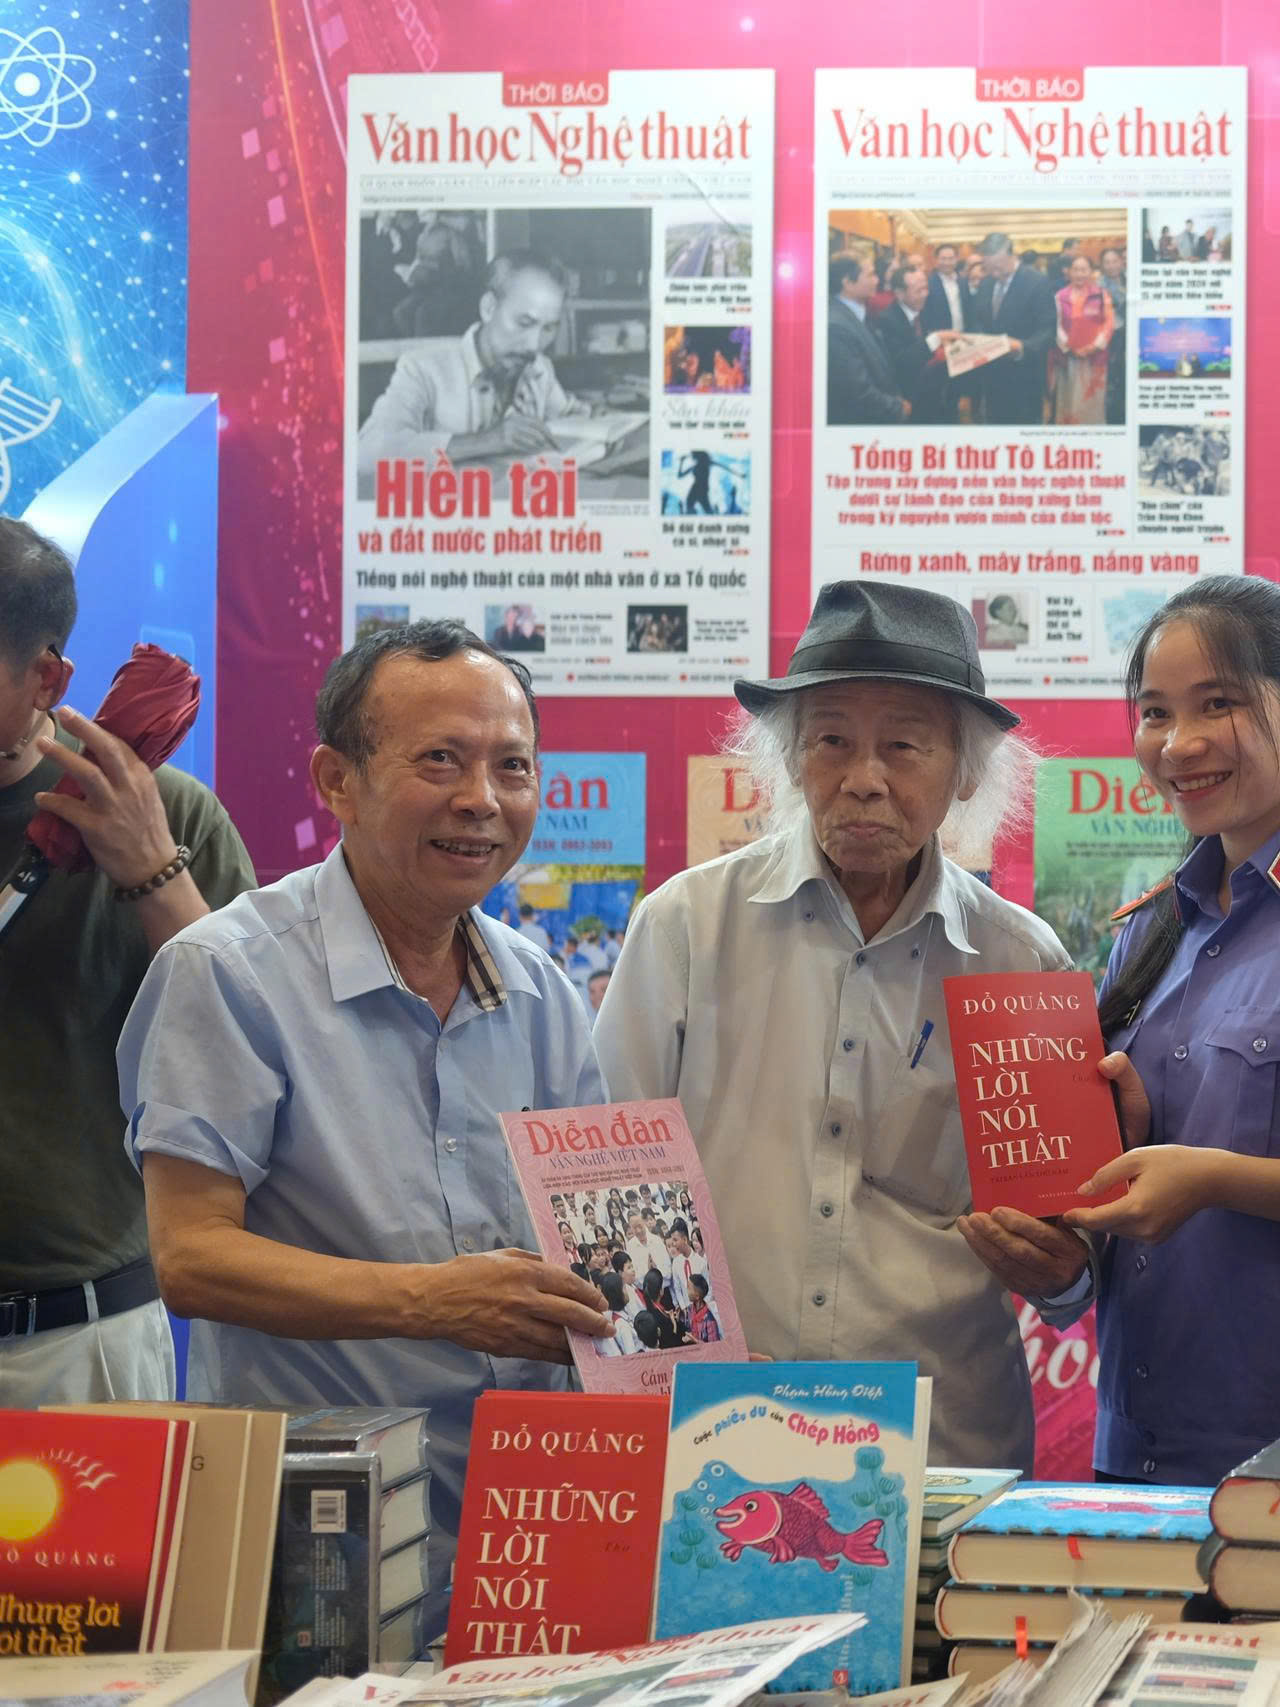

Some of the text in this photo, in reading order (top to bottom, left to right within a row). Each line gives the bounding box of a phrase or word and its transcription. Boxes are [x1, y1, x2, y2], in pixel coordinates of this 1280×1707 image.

[562, 81, 605, 103] BÁO
[1035, 76, 1081, 99] BÁO
[362, 111, 752, 176] Văn học Nghệ thuật
[832, 106, 1232, 174] Văn học Nghệ thuật
[850, 438, 1102, 472] Tổng Bí thư Tô Lâm:
[376, 450, 577, 519] Hiền tài
[359, 523, 602, 557] và đất nước phát triển
[357, 569, 399, 589] Tiếng
[403, 570, 426, 588] nói
[431, 569, 468, 590] nghệ
[474, 570, 515, 589] thuật
[519, 570, 546, 588] của
[550, 570, 582, 590] một
[585, 570, 612, 587] nhà
[618, 572, 645, 587] văn
[664, 574, 681, 587] xa
[686, 566, 704, 588] Tổ
[709, 568, 747, 590] quốc
[860, 549, 1200, 576] Rừng xanh, mây trắng, nắng vàng
[546, 815, 589, 831] NAM
[963, 990, 1081, 1016] ĐỖ QUẢNG
[968, 1032, 1088, 1068] NHỮNG
[973, 1066, 1033, 1102] LỜI
[523, 1109, 674, 1156] Diễn đàn
[977, 1099, 1041, 1136] NÓI
[981, 1132, 1072, 1170] THẬT
[772, 1384, 809, 1400] Phạm
[813, 1384, 849, 1401] Hồng
[489, 1424, 646, 1457] ĐỖ QUẢNG
[713, 1408, 747, 1437] phiêu
[787, 1411, 829, 1447] Chép
[832, 1418, 881, 1445] Hồng
[481, 1482, 639, 1525] NHỮNG
[476, 1524, 551, 1566] LỜI
[470, 1569, 551, 1610] NÓI
